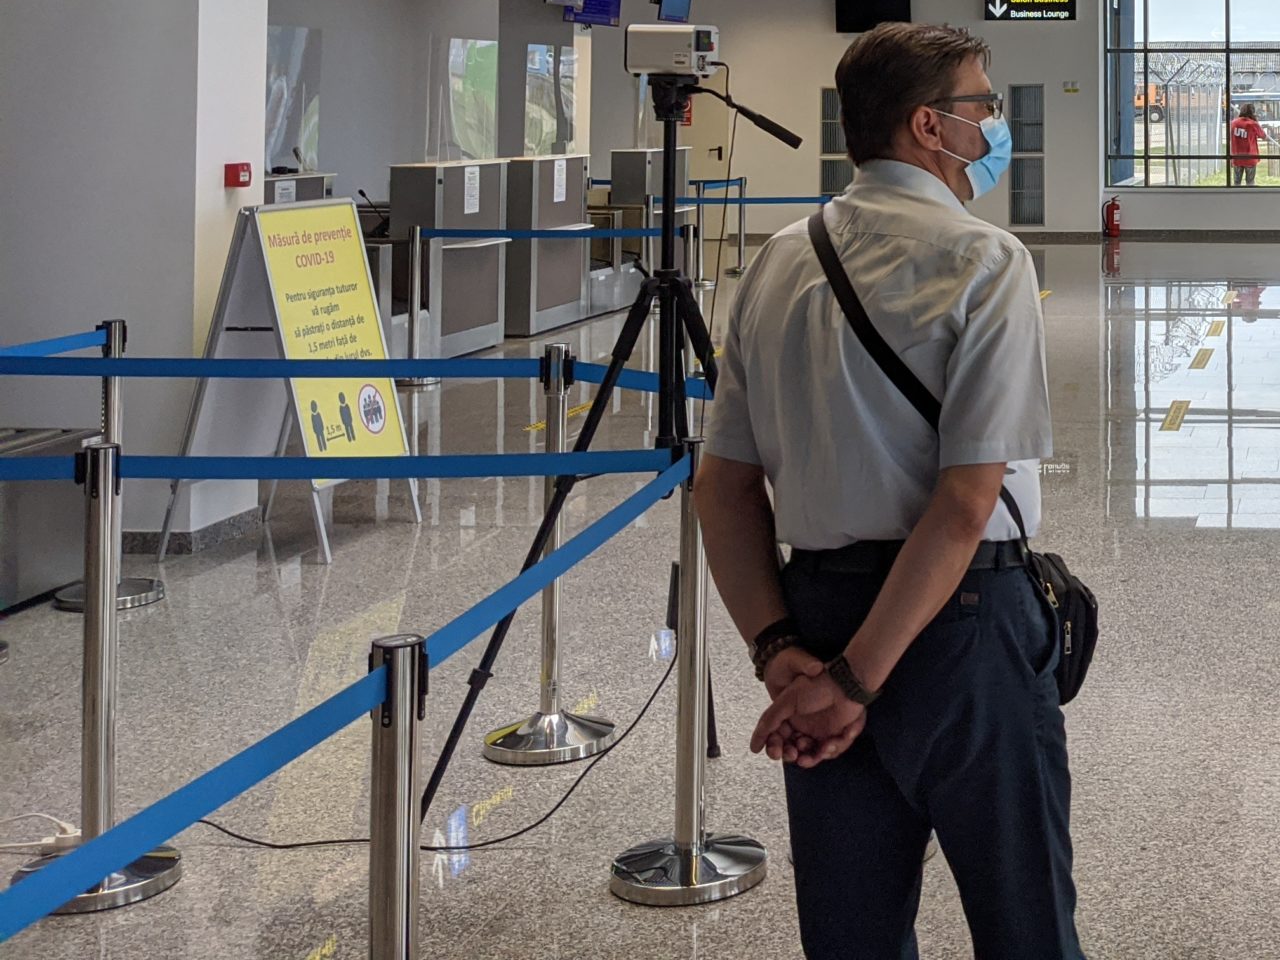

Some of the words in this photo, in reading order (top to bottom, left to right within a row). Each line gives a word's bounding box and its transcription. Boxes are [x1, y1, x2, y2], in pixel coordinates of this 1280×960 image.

[1010, 10, 1041, 18] Business
[1043, 10, 1069, 19] Lounge
[301, 229, 312, 244] de
[295, 250, 335, 268] COVID-19
[285, 292, 307, 302] Pentru
[356, 315, 365, 324] de
[319, 337, 336, 351] metri
